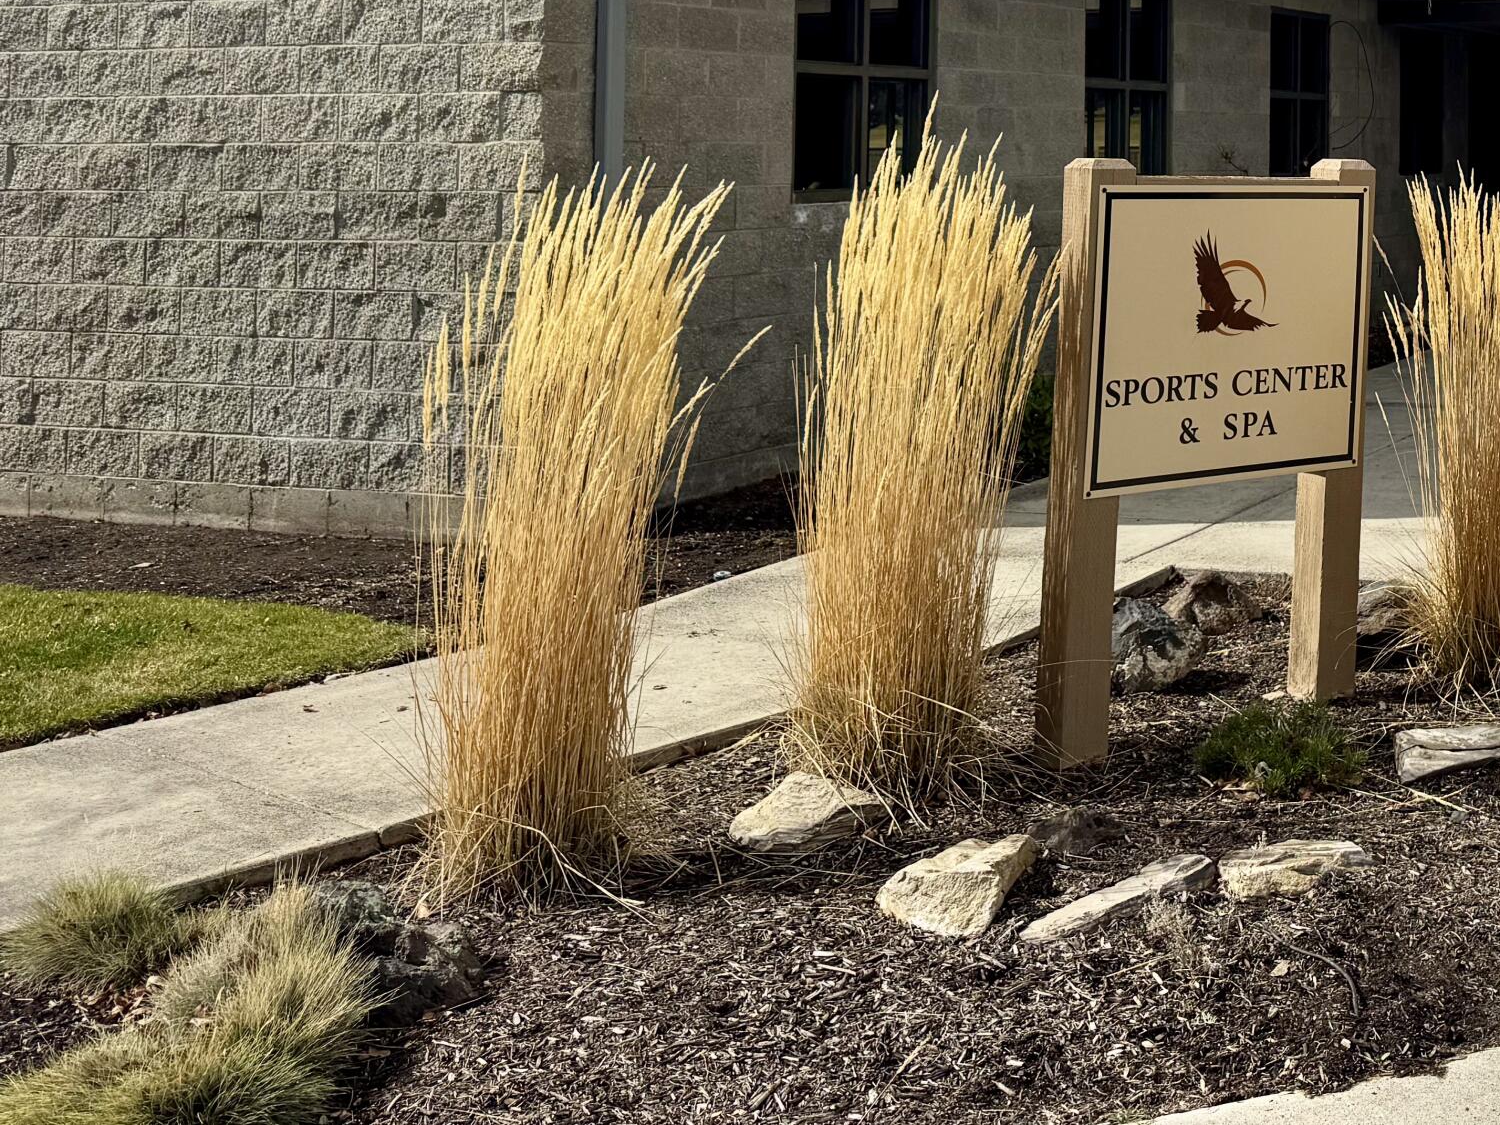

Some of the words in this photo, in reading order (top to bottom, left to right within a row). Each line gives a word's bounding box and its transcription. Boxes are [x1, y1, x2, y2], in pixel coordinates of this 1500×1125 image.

[1105, 372, 1218, 408] SPORTS
[1231, 363, 1348, 396] CENTER
[1179, 417, 1200, 444] &
[1223, 410, 1277, 440] SPA
